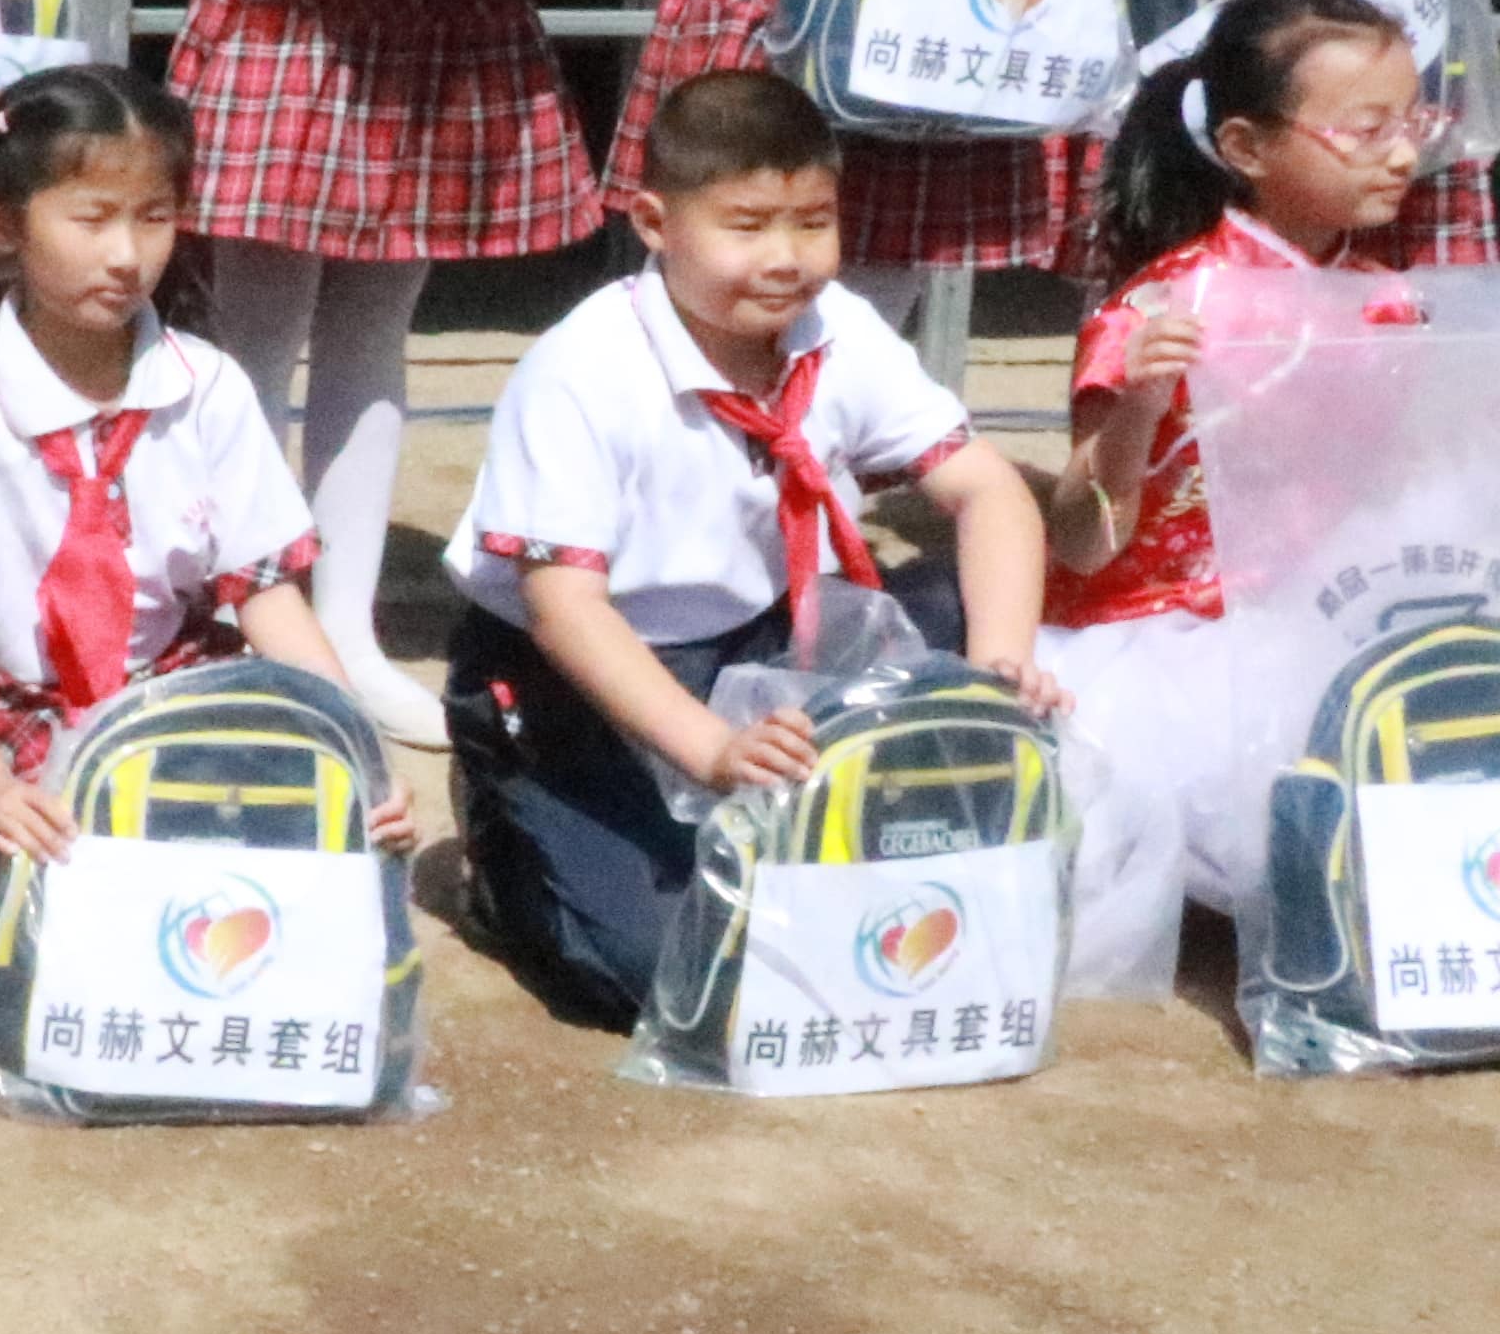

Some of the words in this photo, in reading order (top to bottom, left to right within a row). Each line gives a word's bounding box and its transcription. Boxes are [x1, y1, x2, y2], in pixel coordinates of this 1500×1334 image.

[864, 27, 1106, 100] 尚赫文具套组
[41, 1002, 365, 1075] 尚赫文具套组
[743, 997, 1039, 1069] 尚赫文具套组
